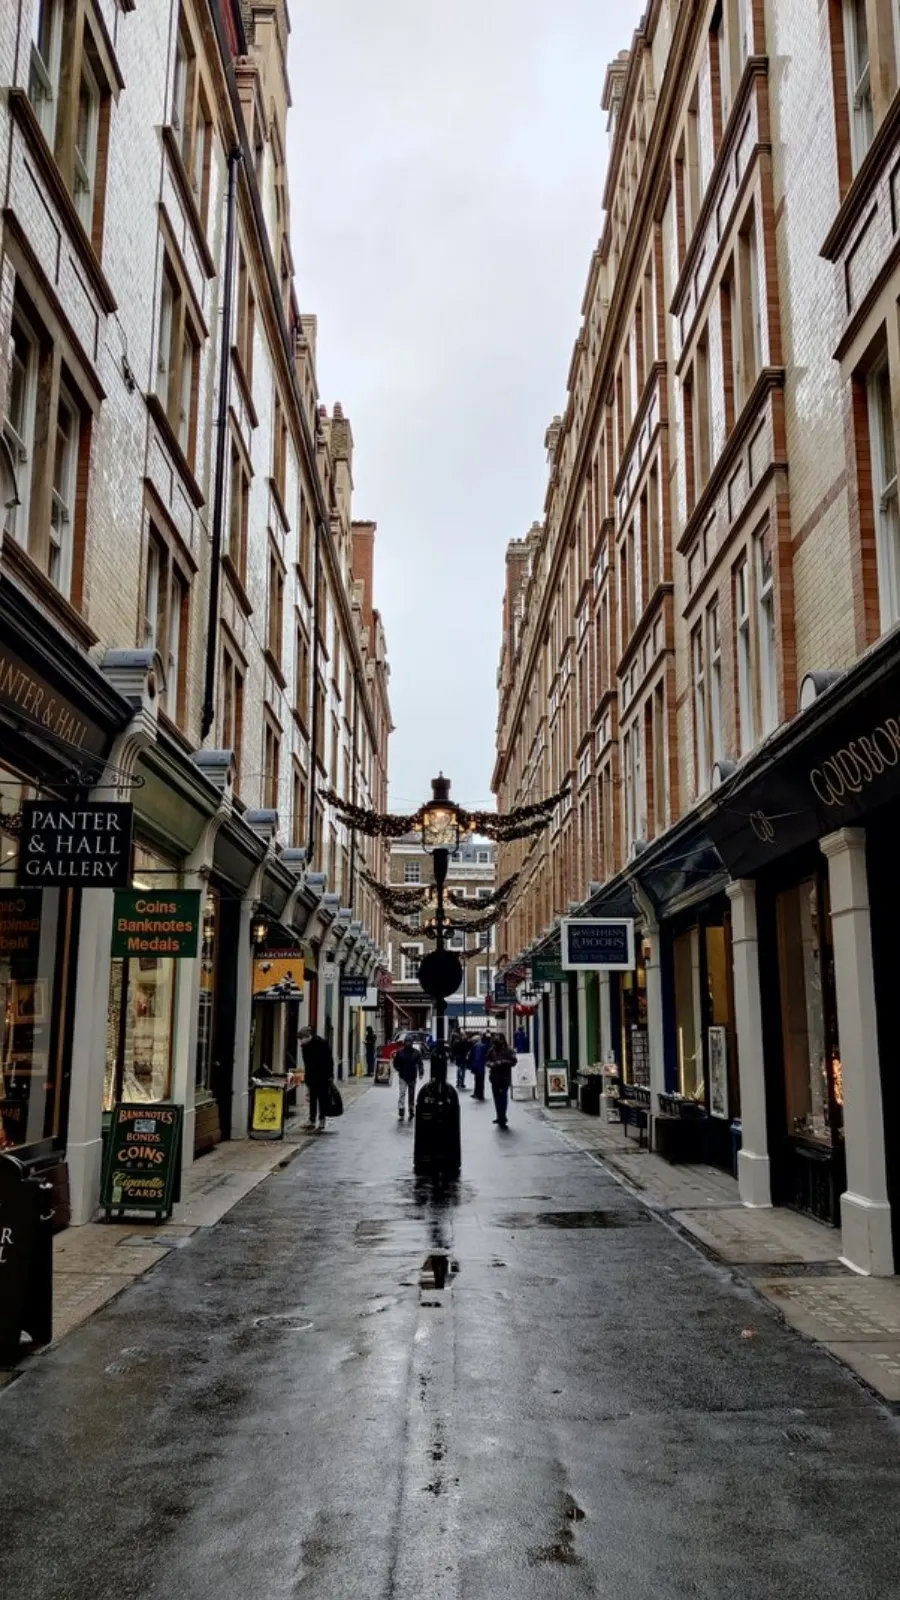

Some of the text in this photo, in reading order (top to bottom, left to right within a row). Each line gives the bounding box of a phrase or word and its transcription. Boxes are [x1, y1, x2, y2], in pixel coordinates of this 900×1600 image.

[41, 698, 56, 727] &
[31, 810, 122, 830] PANTER
[28, 834, 121, 854] & HALL
[26, 860, 119, 877] GALLERY
[135, 899, 177, 914] Coins
[117, 919, 193, 932] Banknotes
[127, 937, 180, 951] Medals
[118, 1109, 174, 1125] BANKNOTES
[126, 1132, 161, 1143] BONDS
[117, 1145, 166, 1164] COINS
[128, 1188, 164, 1199] CARDS
